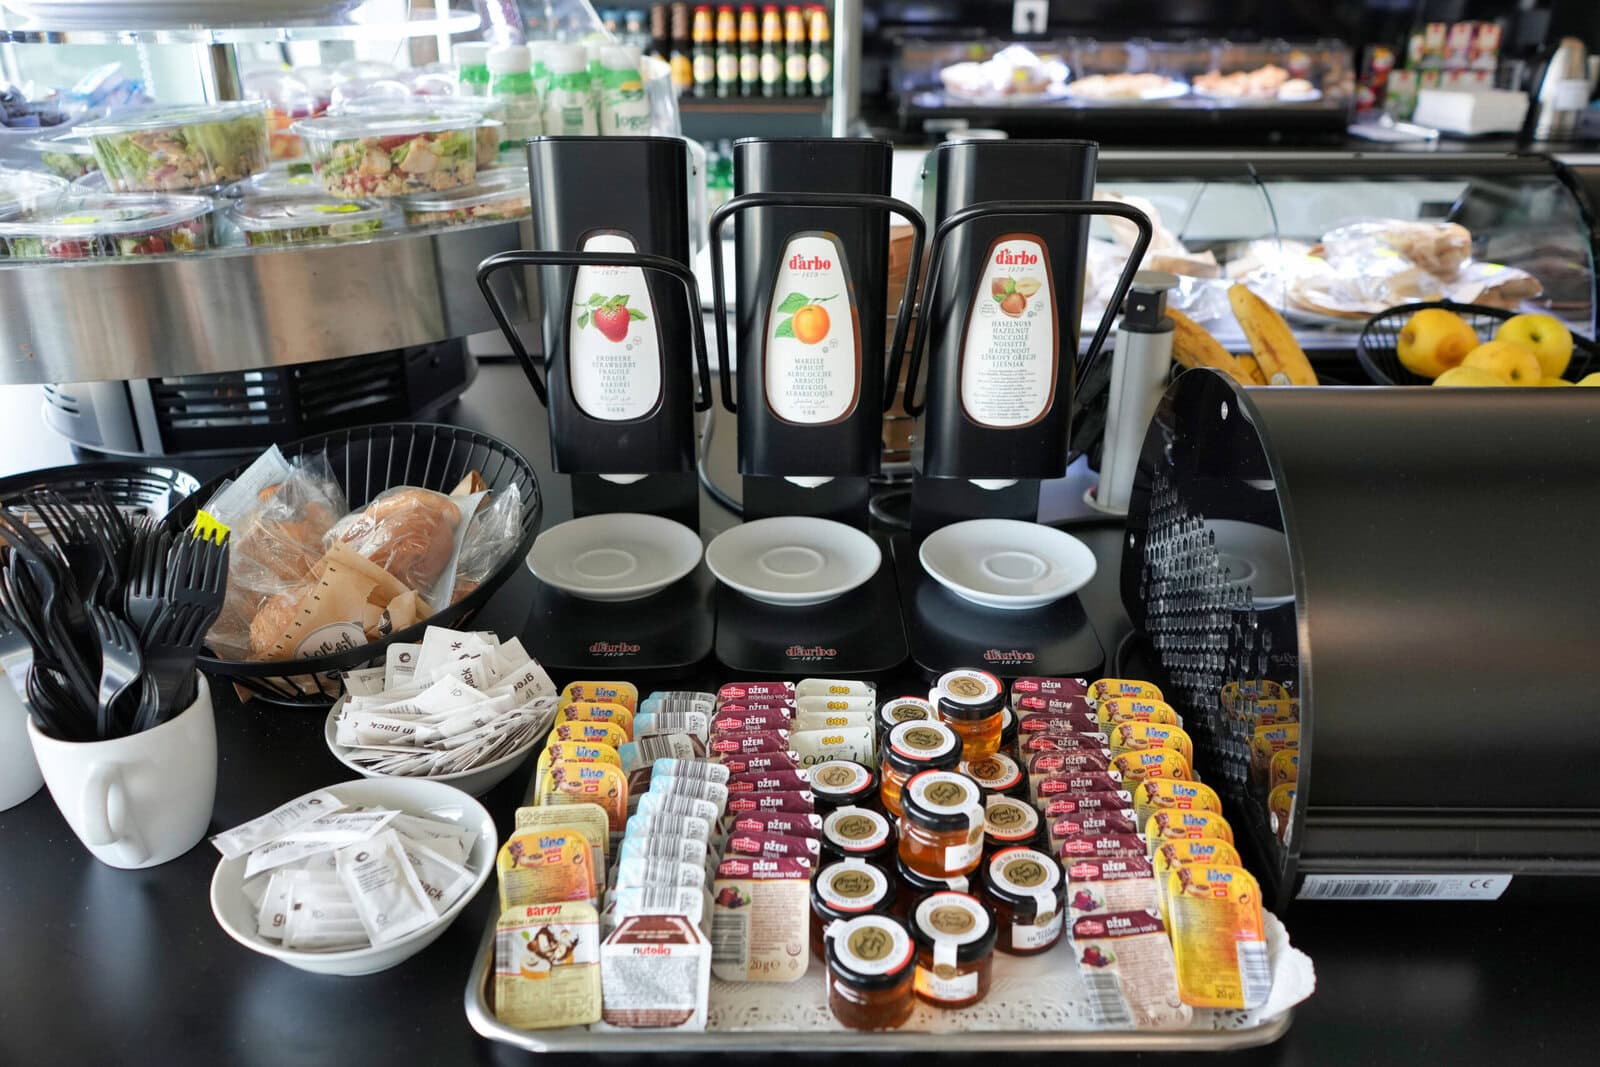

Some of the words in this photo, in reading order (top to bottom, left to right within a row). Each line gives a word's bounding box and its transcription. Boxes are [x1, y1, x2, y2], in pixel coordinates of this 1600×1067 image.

[748, 685, 769, 694] DŽEM
[745, 715, 767, 724] DŽEM
[742, 737, 764, 747] DŽEM
[749, 757, 771, 767] DŽEM
[757, 778, 780, 787] DŽEM
[1070, 778, 1093, 787] DŽEM
[760, 796, 784, 807] DŽEM
[1078, 797, 1101, 807] DŽEM
[767, 819, 792, 831] DŽEM
[1083, 818, 1106, 828] DŽEM
[763, 840, 788, 854] DŽEM
[1096, 838, 1120, 848] DŽEM
[752, 859, 778, 871] DŽEM
[1102, 861, 1127, 872] DŽEM
[1106, 916, 1132, 929] DŽEM
